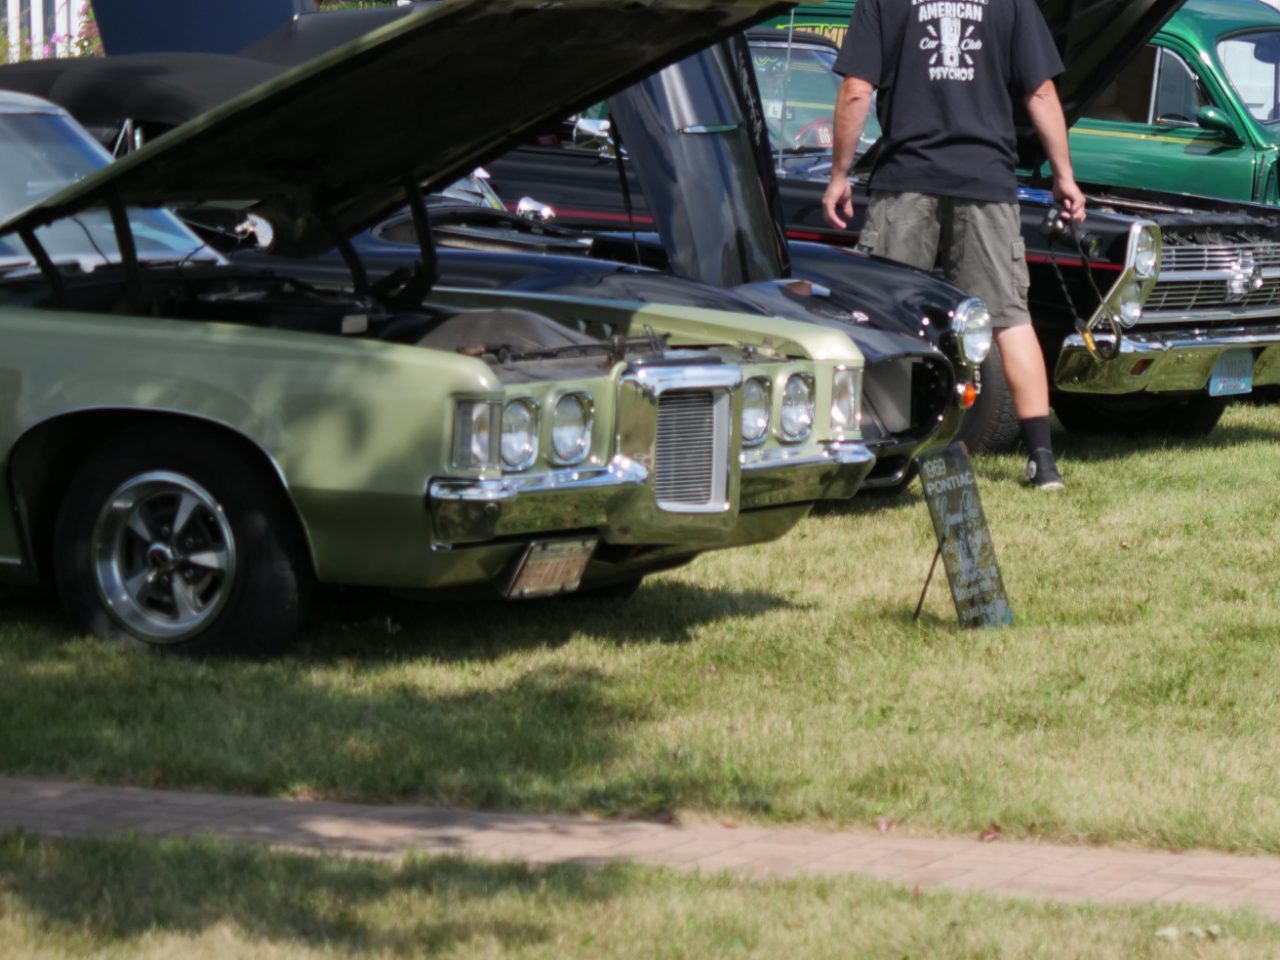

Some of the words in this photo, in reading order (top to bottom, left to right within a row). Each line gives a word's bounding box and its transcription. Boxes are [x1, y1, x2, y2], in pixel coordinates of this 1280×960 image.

[919, 1, 983, 22] AMERICAN
[919, 37, 939, 50] Car
[929, 67, 974, 81] PSYCHOS
[926, 471, 973, 496] PONTIAC
